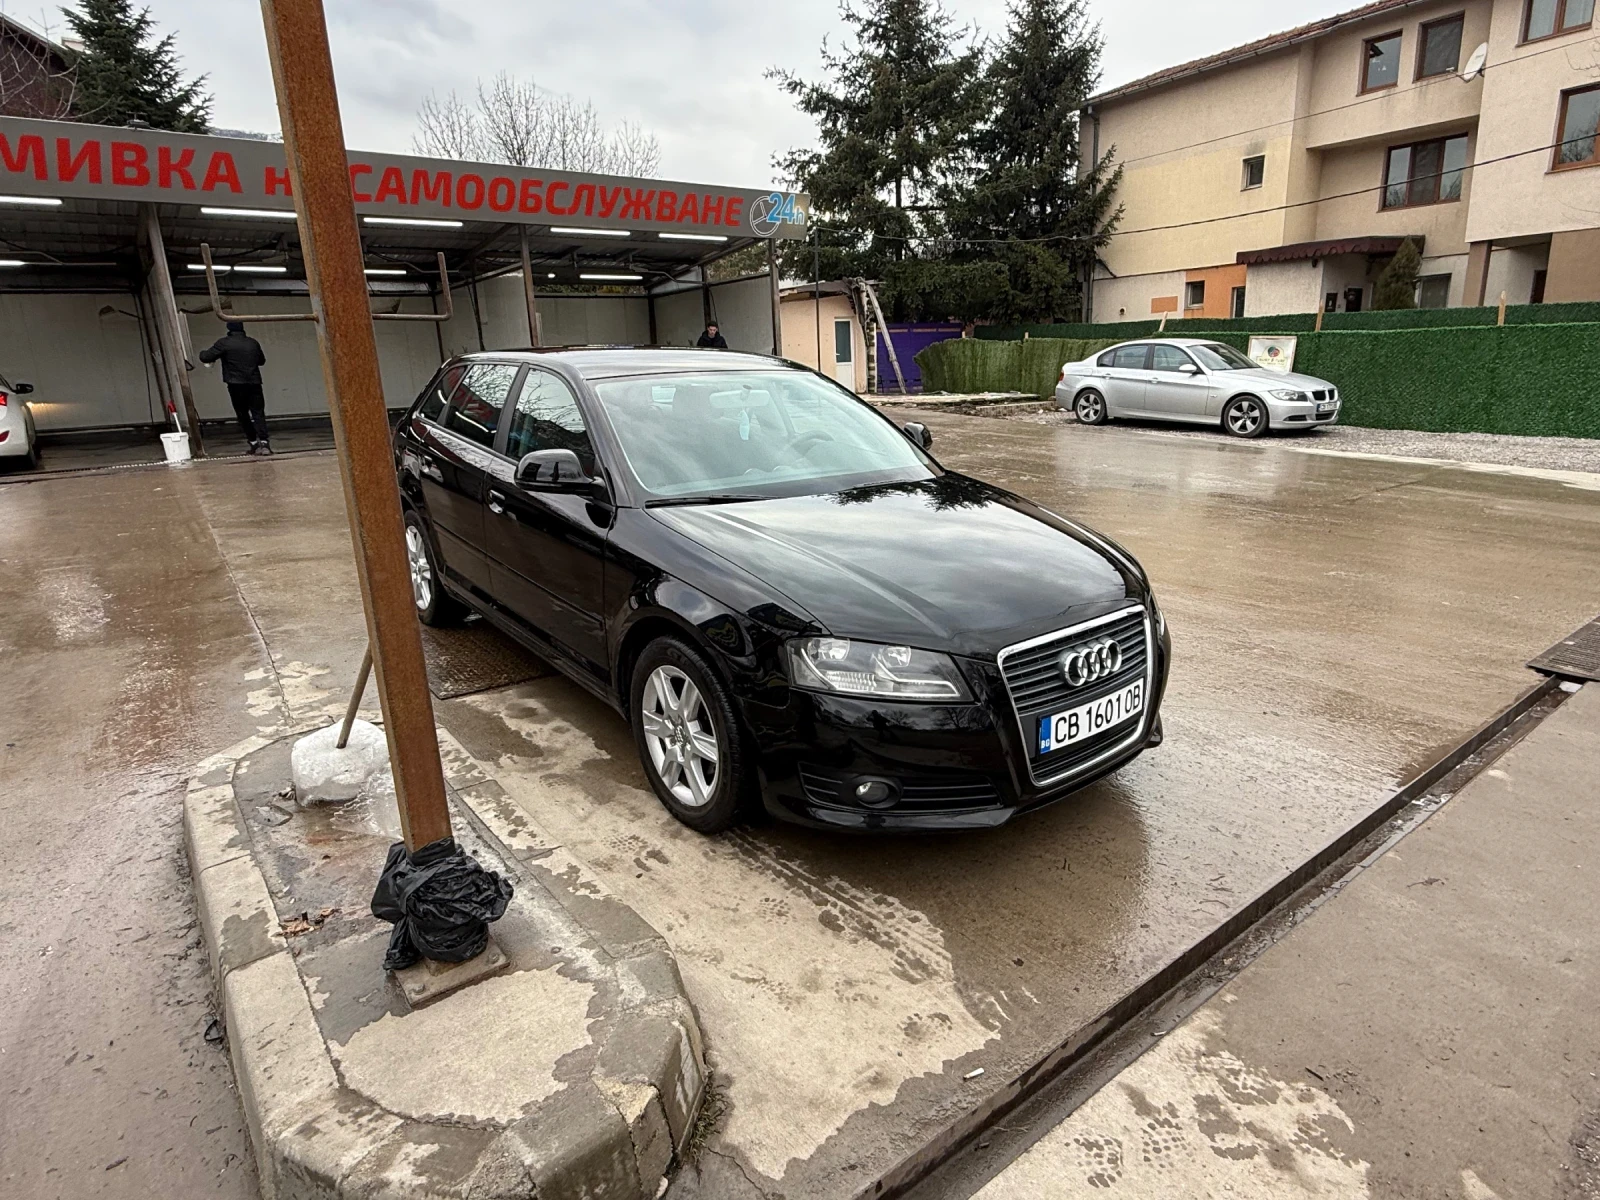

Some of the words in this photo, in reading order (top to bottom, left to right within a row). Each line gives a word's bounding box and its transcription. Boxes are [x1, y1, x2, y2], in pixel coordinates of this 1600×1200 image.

[0, 132, 243, 194] МИВКА
[348, 163, 744, 227] САМООБСЛУЖВАНЕ
[766, 192, 805, 226] 24h
[1055, 712, 1080, 744] CB
[1086, 693, 1122, 733] 1601
[1040, 739, 1050, 749] BG
